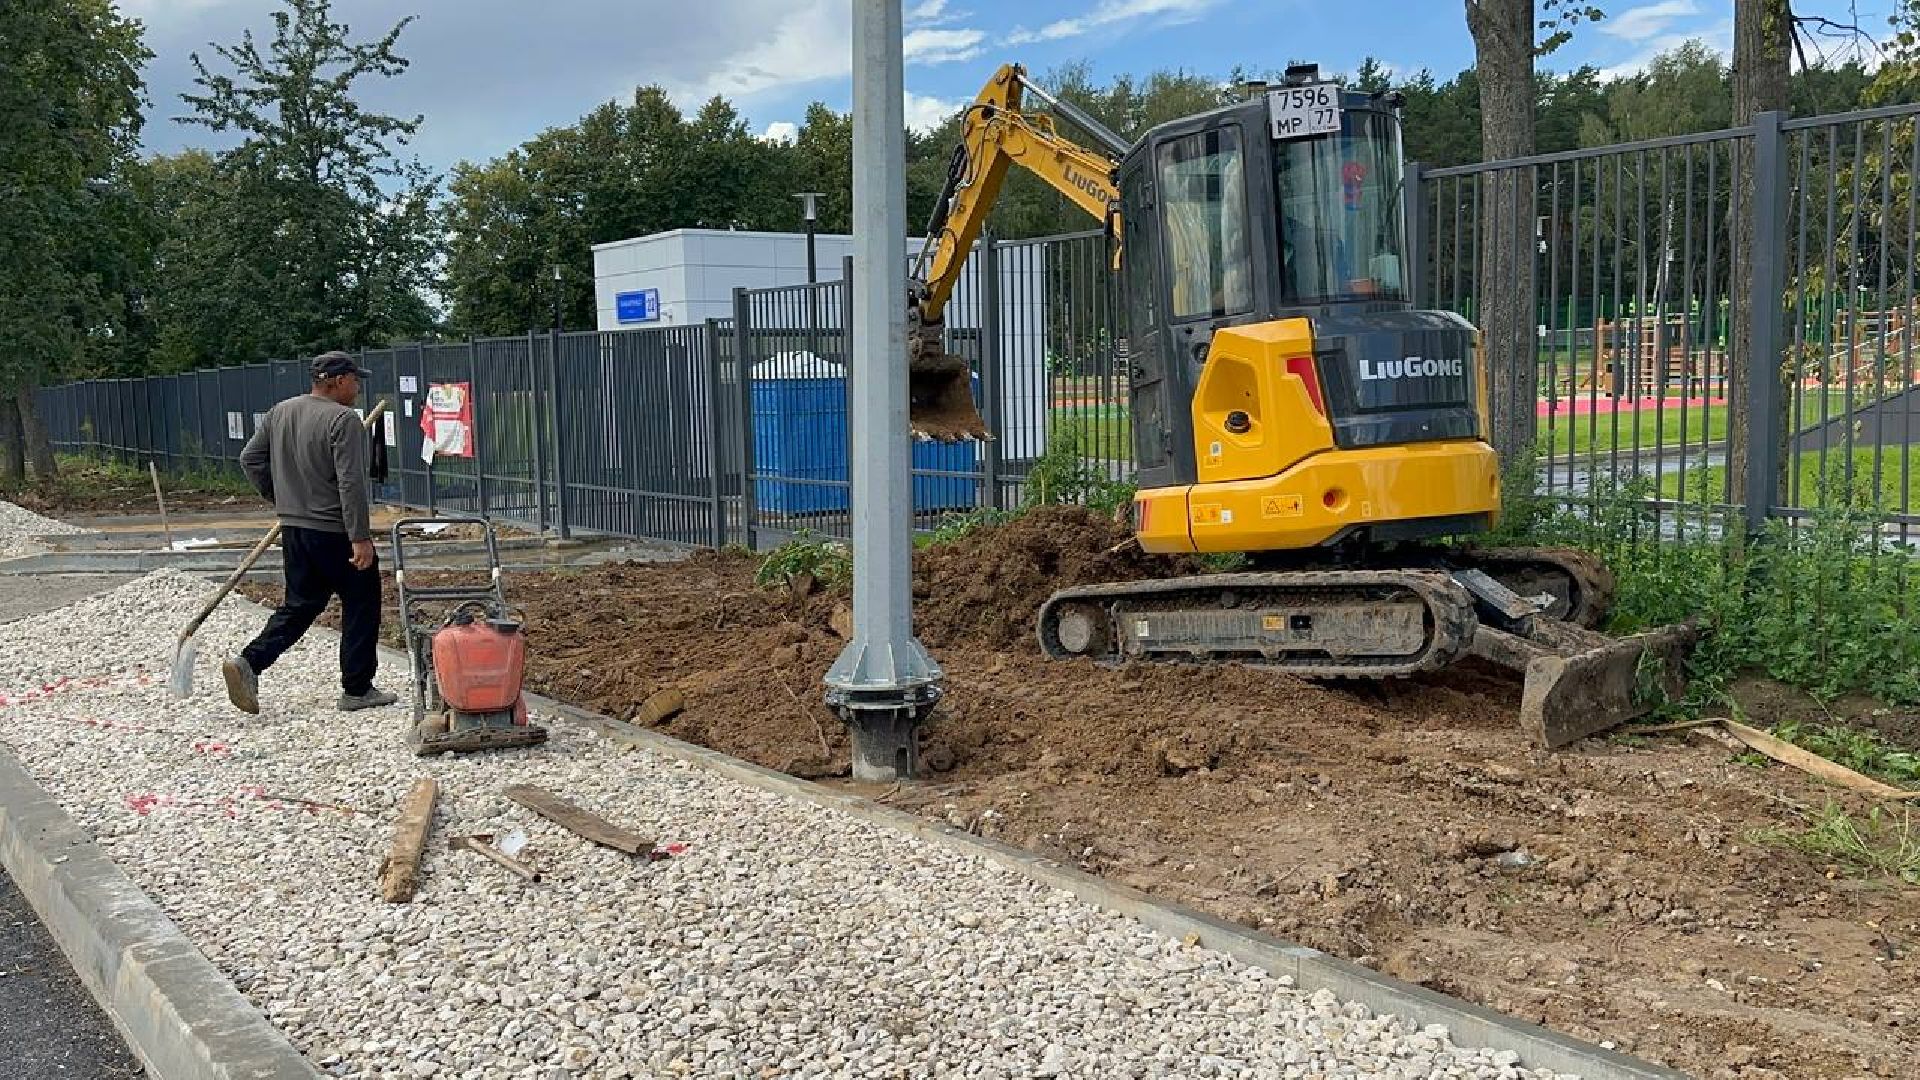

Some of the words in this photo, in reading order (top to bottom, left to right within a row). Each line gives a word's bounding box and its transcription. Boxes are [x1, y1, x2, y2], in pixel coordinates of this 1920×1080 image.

[1277, 87, 1329, 111] 7596
[1277, 117, 1302, 135] МР
[1314, 109, 1334, 125] 77
[1062, 164, 1113, 204] LIUGO
